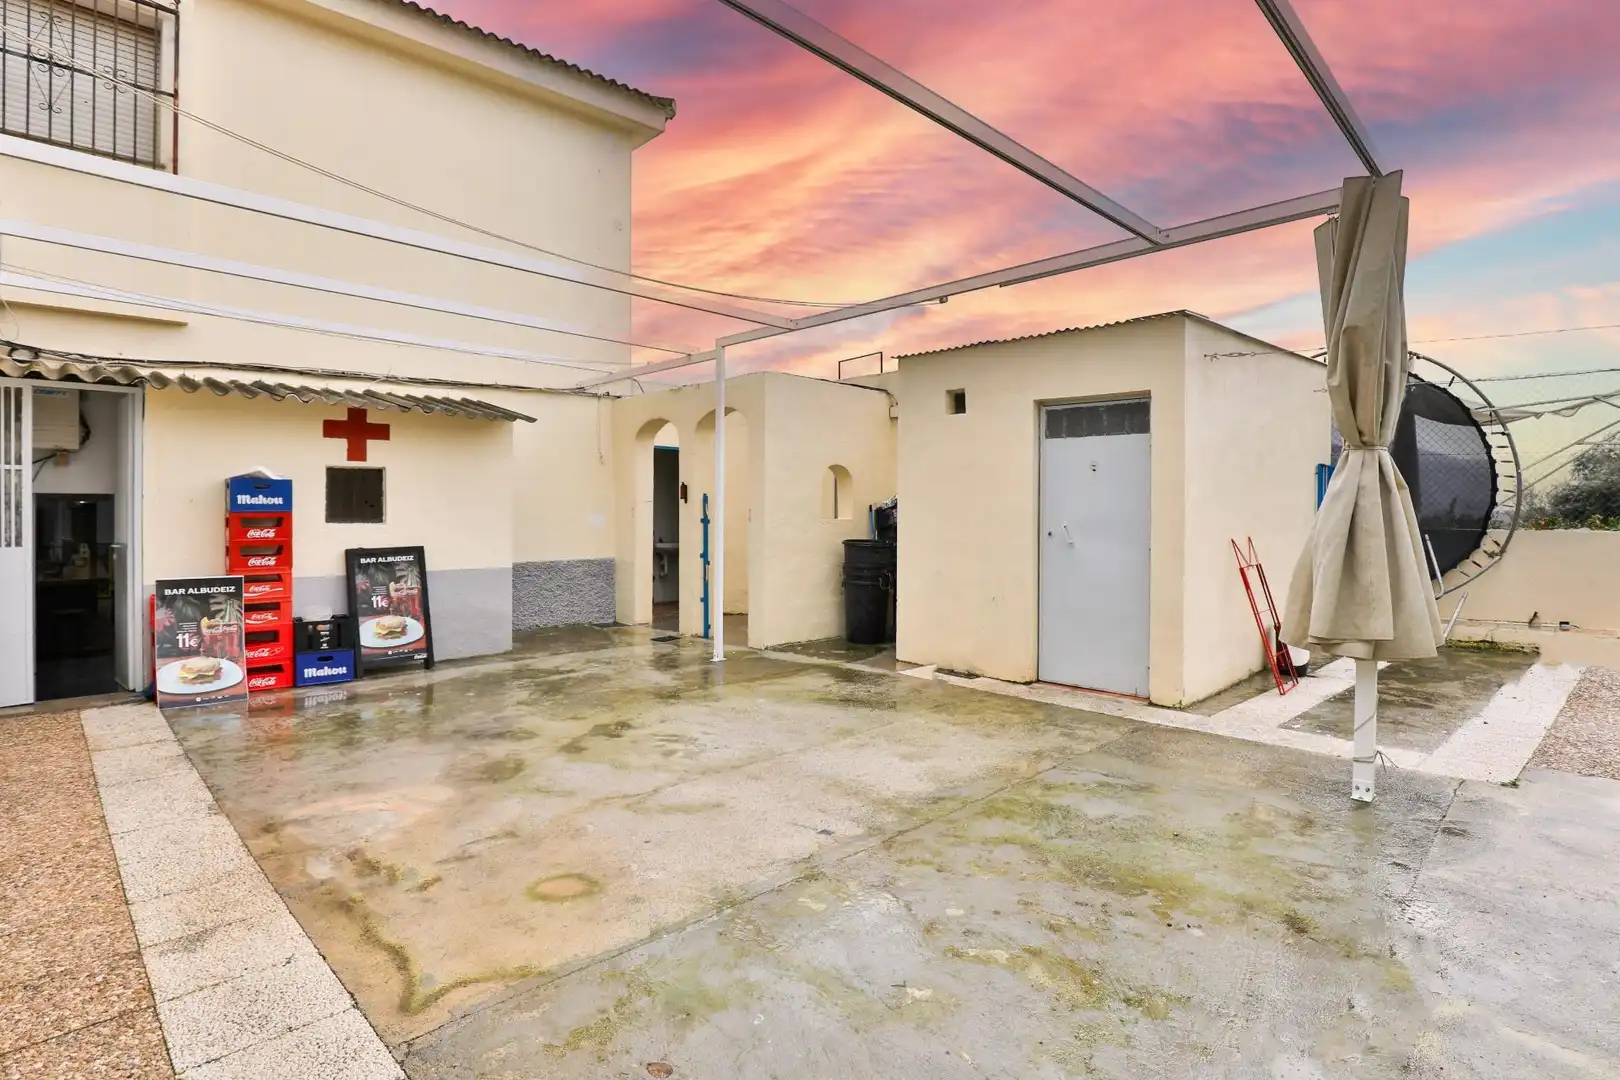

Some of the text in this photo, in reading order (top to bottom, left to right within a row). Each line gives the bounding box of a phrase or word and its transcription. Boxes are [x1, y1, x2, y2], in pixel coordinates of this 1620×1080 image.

[236, 494, 284, 505] Mahou
[164, 585, 236, 596] BAR ALBUDEIZ
[176, 633, 199, 648] 11€
[303, 665, 348, 678] Mahou
